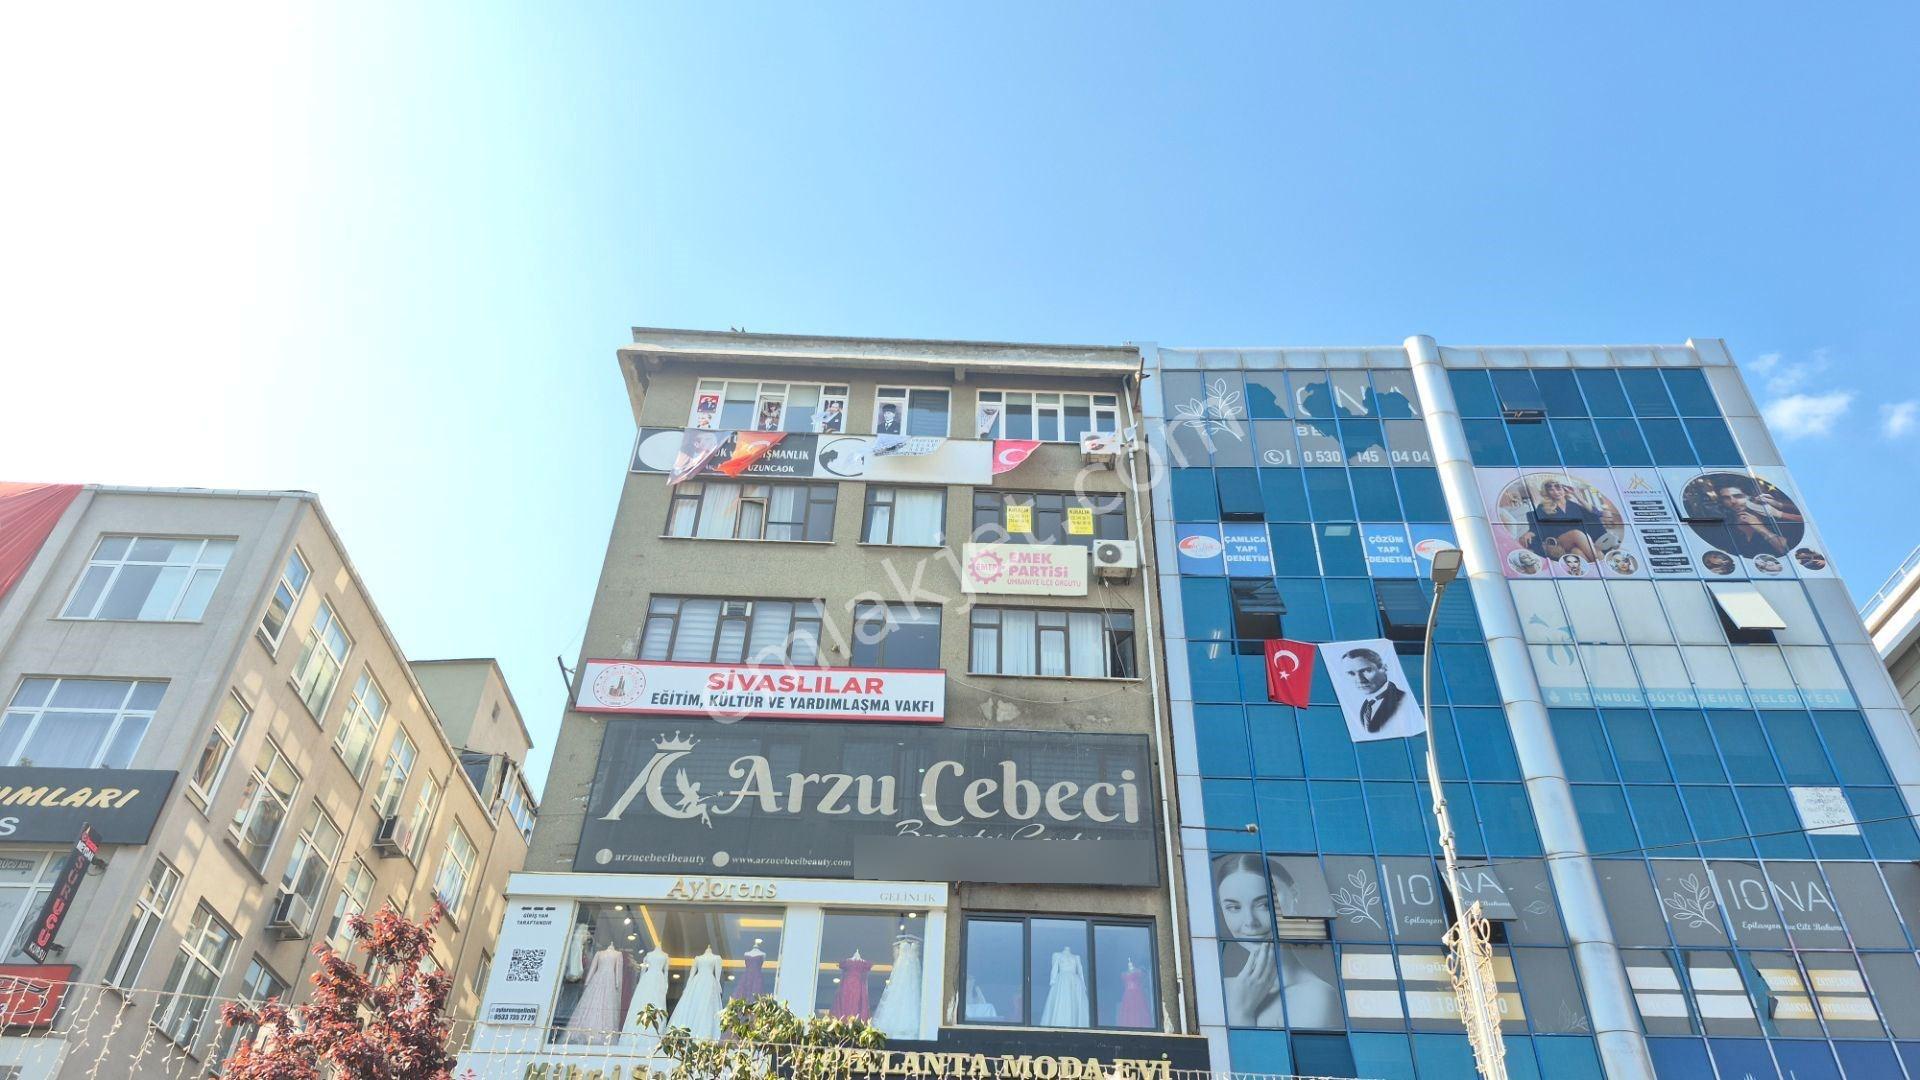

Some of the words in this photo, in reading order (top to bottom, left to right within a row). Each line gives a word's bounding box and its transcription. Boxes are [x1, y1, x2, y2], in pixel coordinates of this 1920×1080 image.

[1316, 450, 1341, 463] 530
[1392, 450, 1409, 462] 04
[1412, 450, 1430, 462] 04
[1368, 535, 1404, 545] ÇÖZÜM
[1008, 552, 1052, 564] EMEK
[707, 669, 884, 695] SİVASLILAR
[650, 689, 704, 709] EĞİTİM,
[709, 691, 764, 709] KÜLTÜR
[768, 696, 786, 710] VE
[789, 696, 890, 714] YARDIMLAŞMA
[895, 699, 935, 713] VAKFI
[711, 755, 899, 816] Arzu
[919, 759, 1140, 827] Cebeci
[614, 852, 706, 865] arzucebecibeauty
[731, 856, 852, 868] www.arzucebecibeauty.com
[667, 877, 778, 900] Aylorens
[1727, 878, 1836, 913] IONA
[1742, 921, 1781, 932] Epilasyon
[1000, 1054, 1105, 1080] MODA
[1112, 1052, 1172, 1080] EVİ
